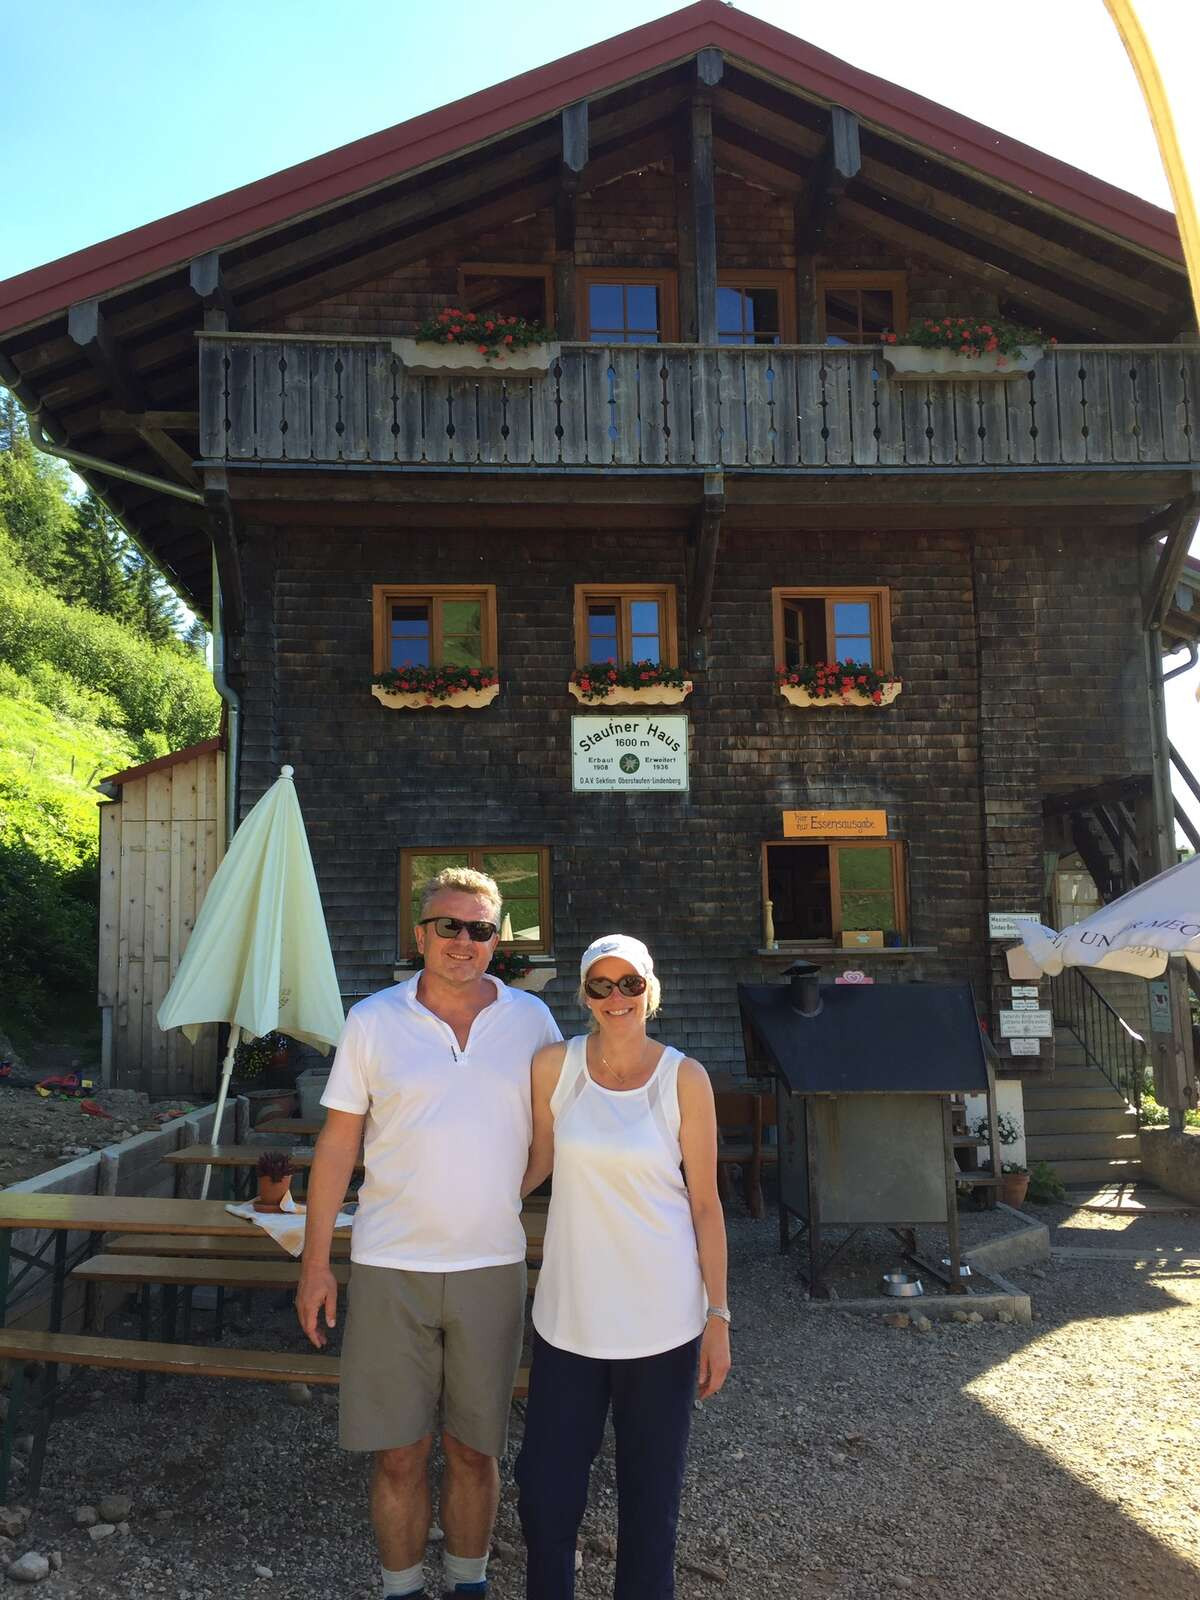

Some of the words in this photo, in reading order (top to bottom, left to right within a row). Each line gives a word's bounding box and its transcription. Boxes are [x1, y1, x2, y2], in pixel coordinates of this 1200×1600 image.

[579, 723, 639, 752] Staufner
[647, 723, 681, 752] Haus
[615, 738, 638, 747] 1600
[639, 739, 650, 747] m
